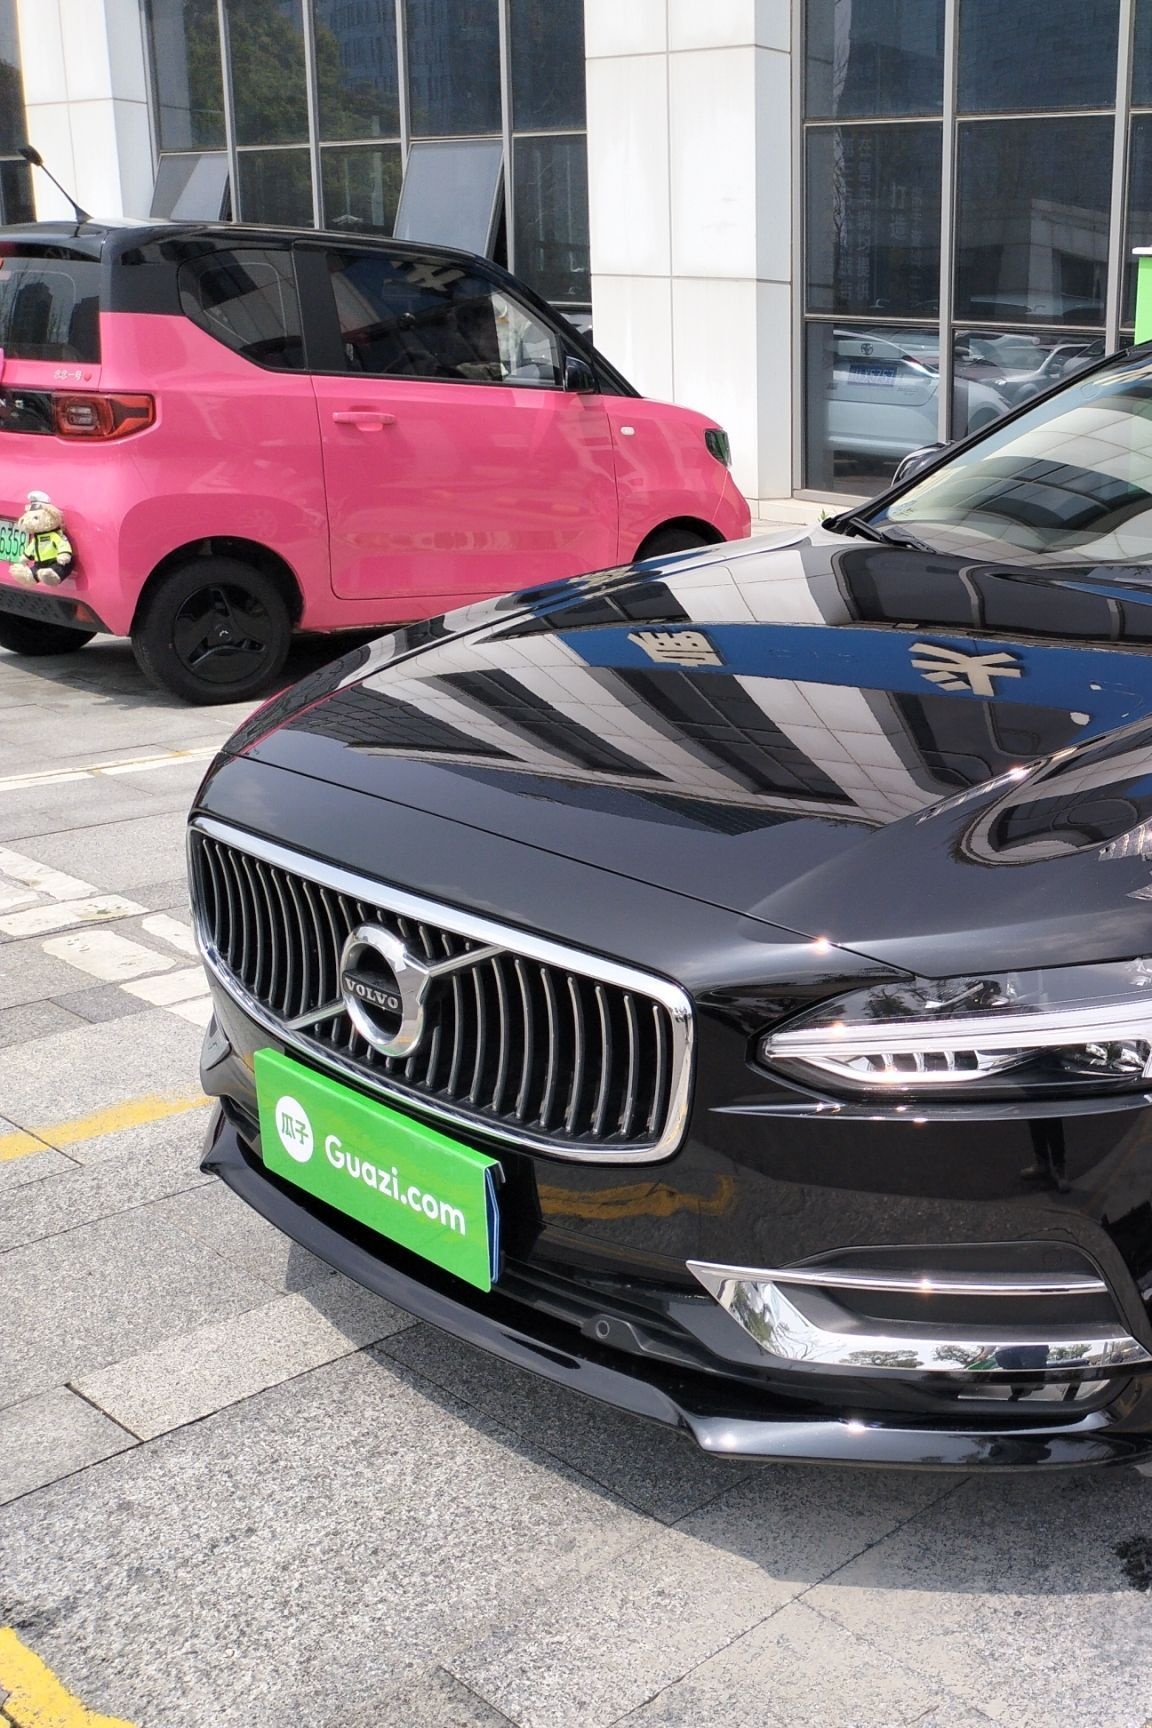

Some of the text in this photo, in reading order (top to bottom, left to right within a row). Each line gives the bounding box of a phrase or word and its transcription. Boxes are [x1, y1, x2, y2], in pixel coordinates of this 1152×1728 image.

[344, 976, 399, 1011] VOLVO
[281, 1113, 310, 1146] 瓜子
[324, 1134, 467, 1236] Guazi.com
